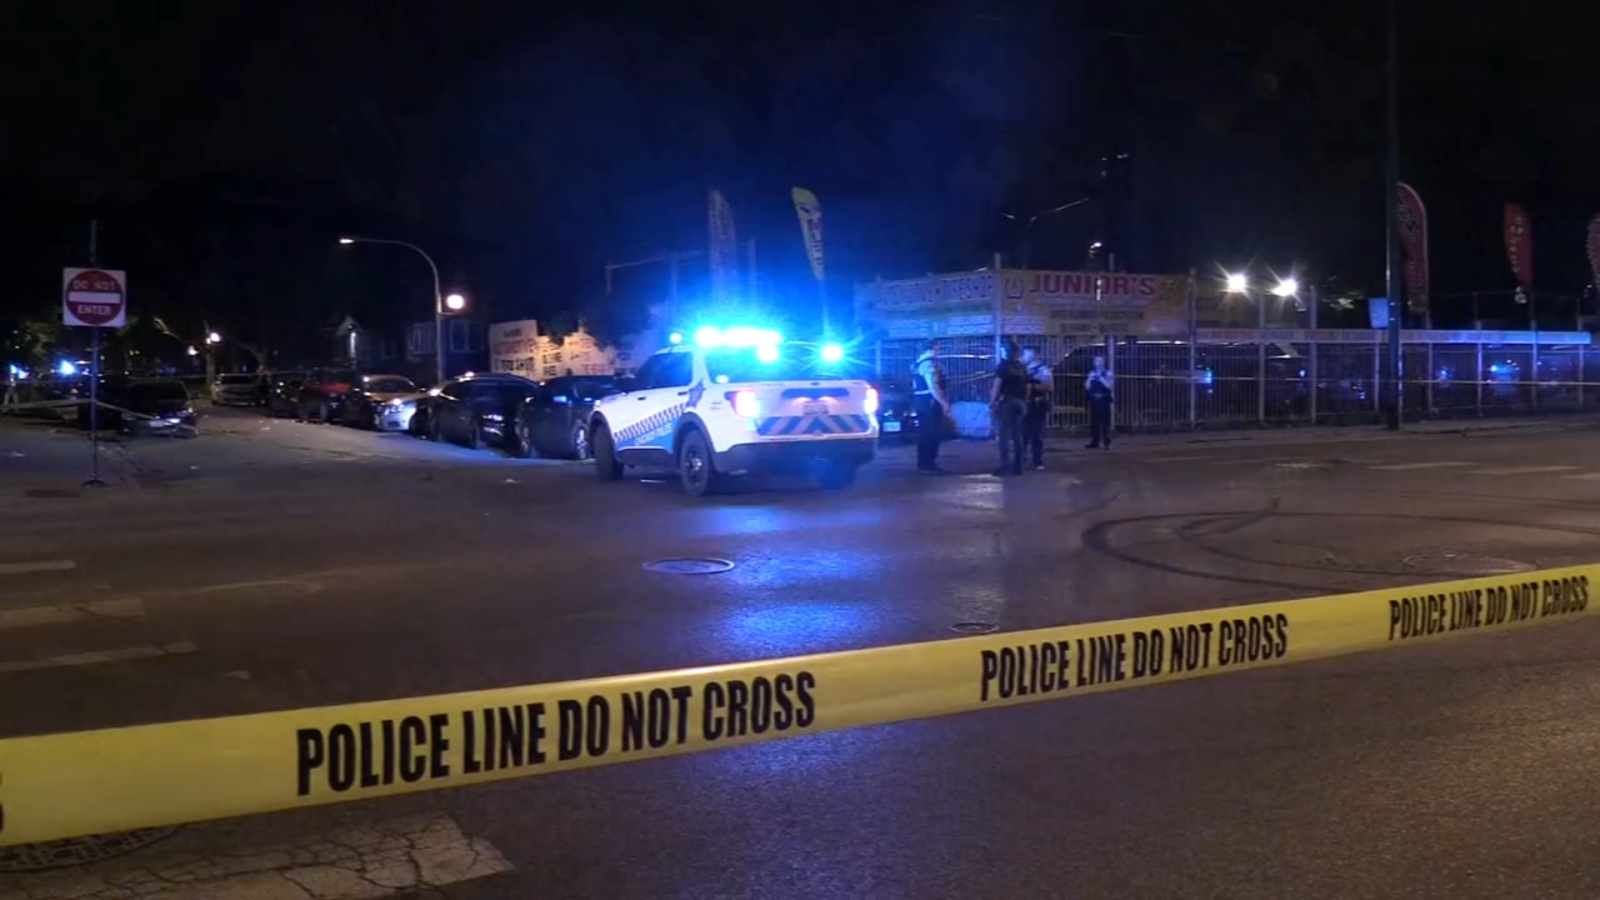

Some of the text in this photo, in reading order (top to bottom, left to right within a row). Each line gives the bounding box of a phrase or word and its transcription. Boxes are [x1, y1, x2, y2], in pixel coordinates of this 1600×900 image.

[73, 280, 115, 290] DO NOT
[1029, 274, 1155, 295] JUNIOR'S
[78, 305, 111, 315] ENTER
[1389, 575, 1589, 641] POLICE LINE DO NOT CROSS
[980, 613, 1288, 701] POLICE LINE DO NOT CROSS
[296, 671, 816, 796] POLICE LINE DO NOT CROSS
